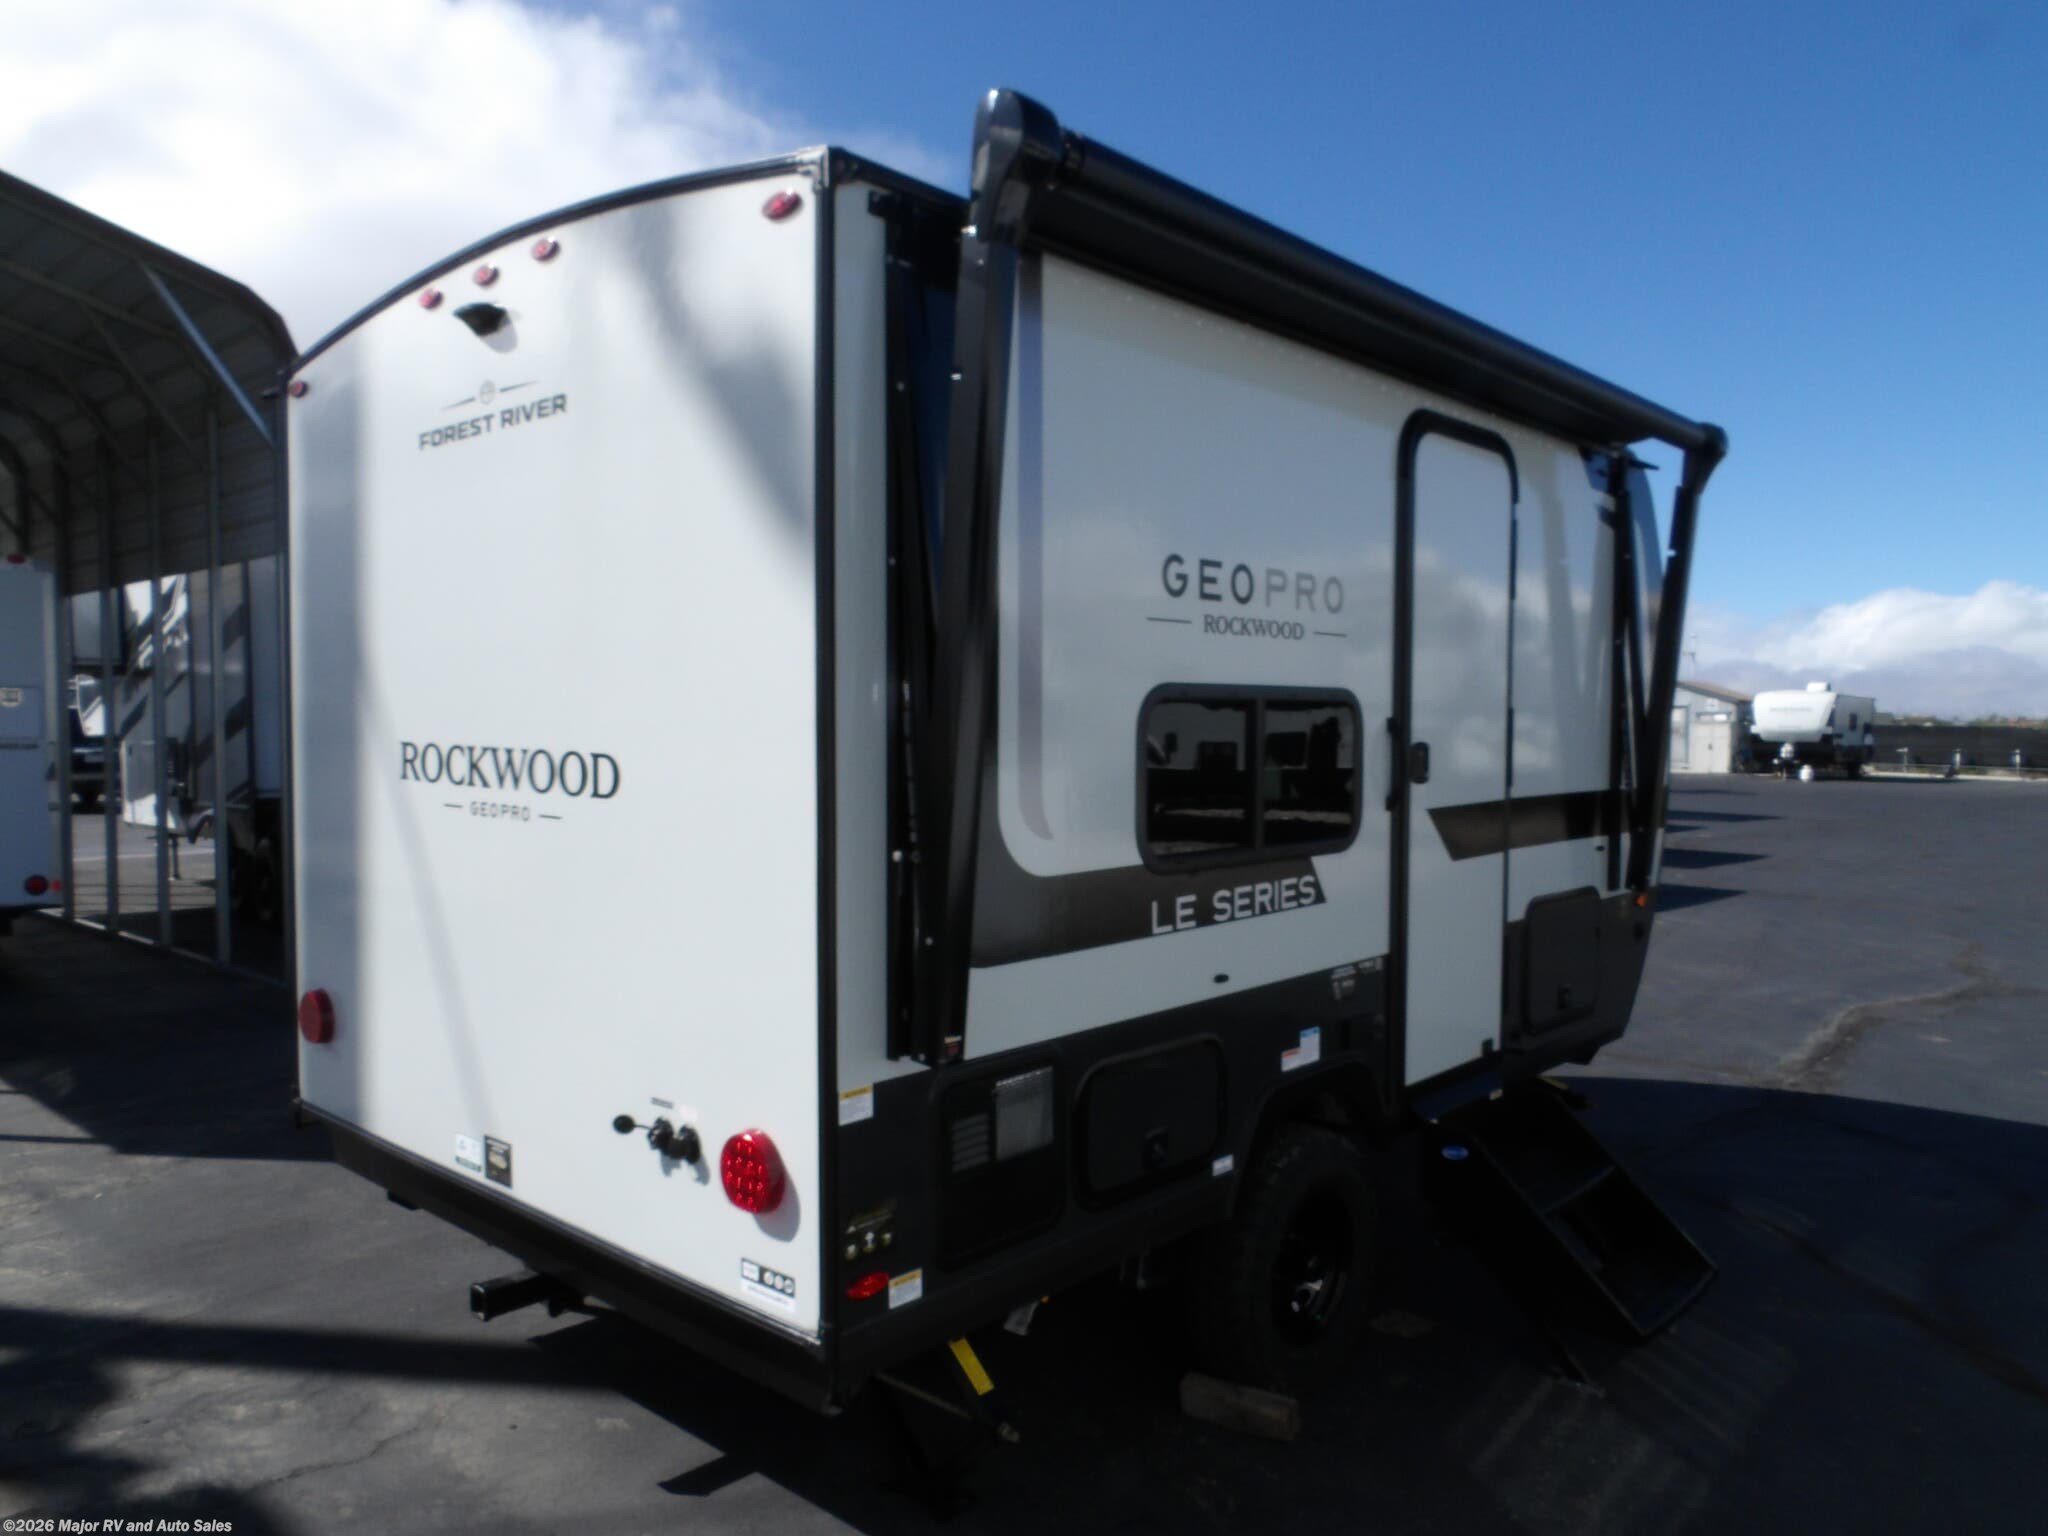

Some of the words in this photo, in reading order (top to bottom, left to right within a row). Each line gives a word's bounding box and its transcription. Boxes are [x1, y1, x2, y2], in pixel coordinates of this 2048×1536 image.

[418, 413, 495, 450] FOREST
[500, 393, 567, 429] RIVER
[1162, 553, 1344, 614] GEOPRO
[1203, 613, 1305, 640] ROCKWOOD
[400, 741, 620, 799] ROCKWOOD
[470, 801, 531, 822] GEOPRO
[1151, 894, 1198, 935] LE
[1212, 875, 1316, 922] SERIES
